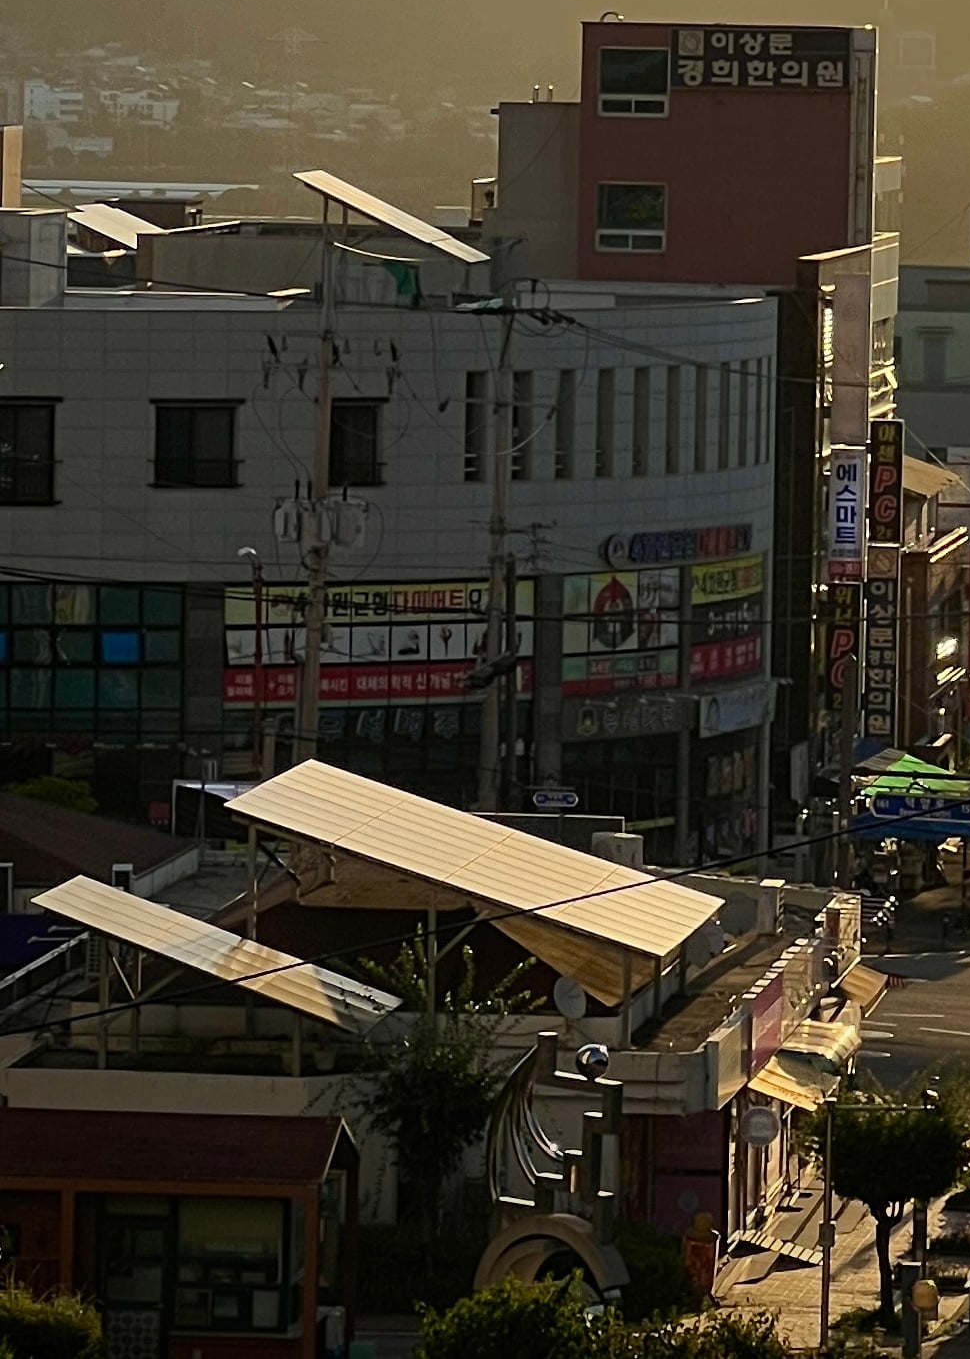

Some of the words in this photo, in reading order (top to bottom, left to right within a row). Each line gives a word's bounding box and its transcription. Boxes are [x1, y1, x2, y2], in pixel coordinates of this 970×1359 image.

[711, 32, 793, 56] 이상문
[677, 59, 844, 87] 경희한의원
[836, 463, 858, 544] 에스마트
[874, 465, 897, 522] PC
[869, 581, 895, 647] 이상문
